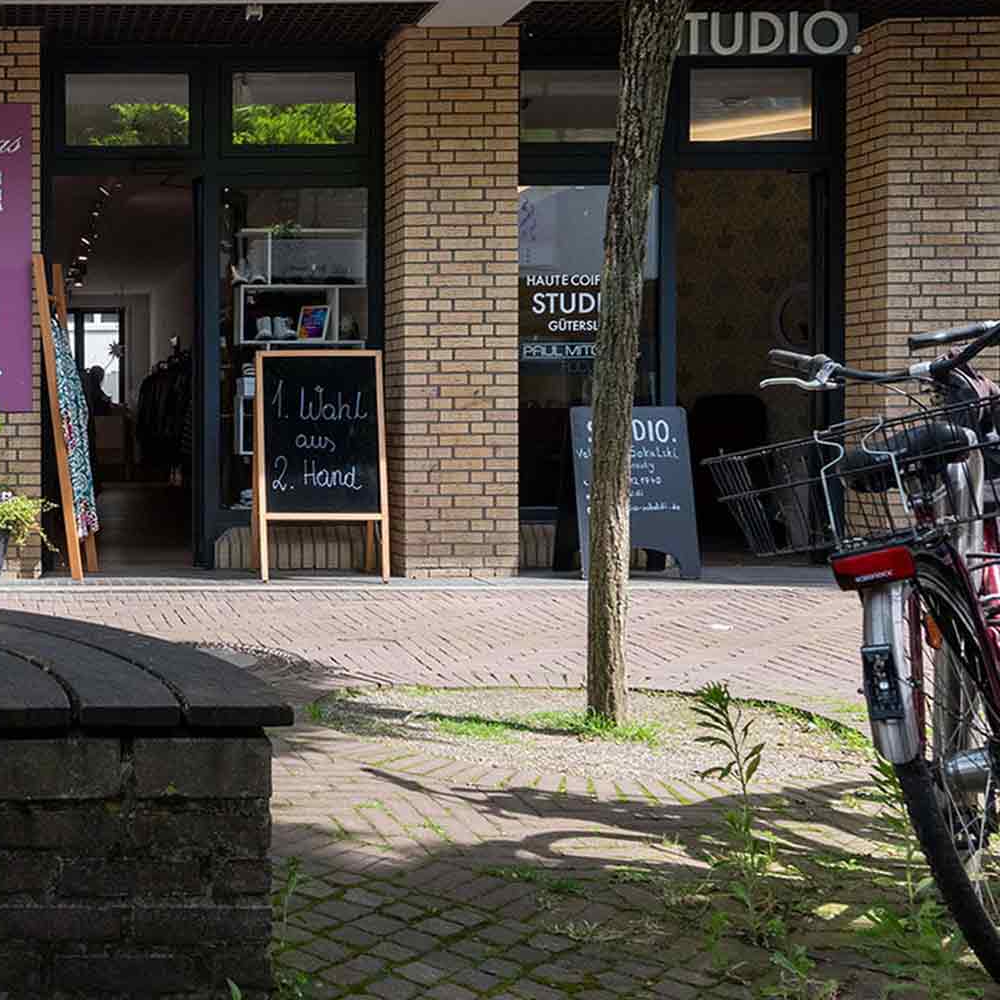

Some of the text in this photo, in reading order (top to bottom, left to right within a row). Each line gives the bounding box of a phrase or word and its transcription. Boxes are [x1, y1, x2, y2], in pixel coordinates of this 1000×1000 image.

[676, 10, 862, 55] TUDIO.
[527, 274, 600, 286] HAUTE COIF
[532, 292, 600, 314] STUDI
[548, 318, 599, 332] GÜTERSL
[523, 345, 563, 358] PAUL
[300, 386, 368, 421] Wahl
[295, 433, 337, 452] aus
[272, 455, 363, 492] 2. Hand
